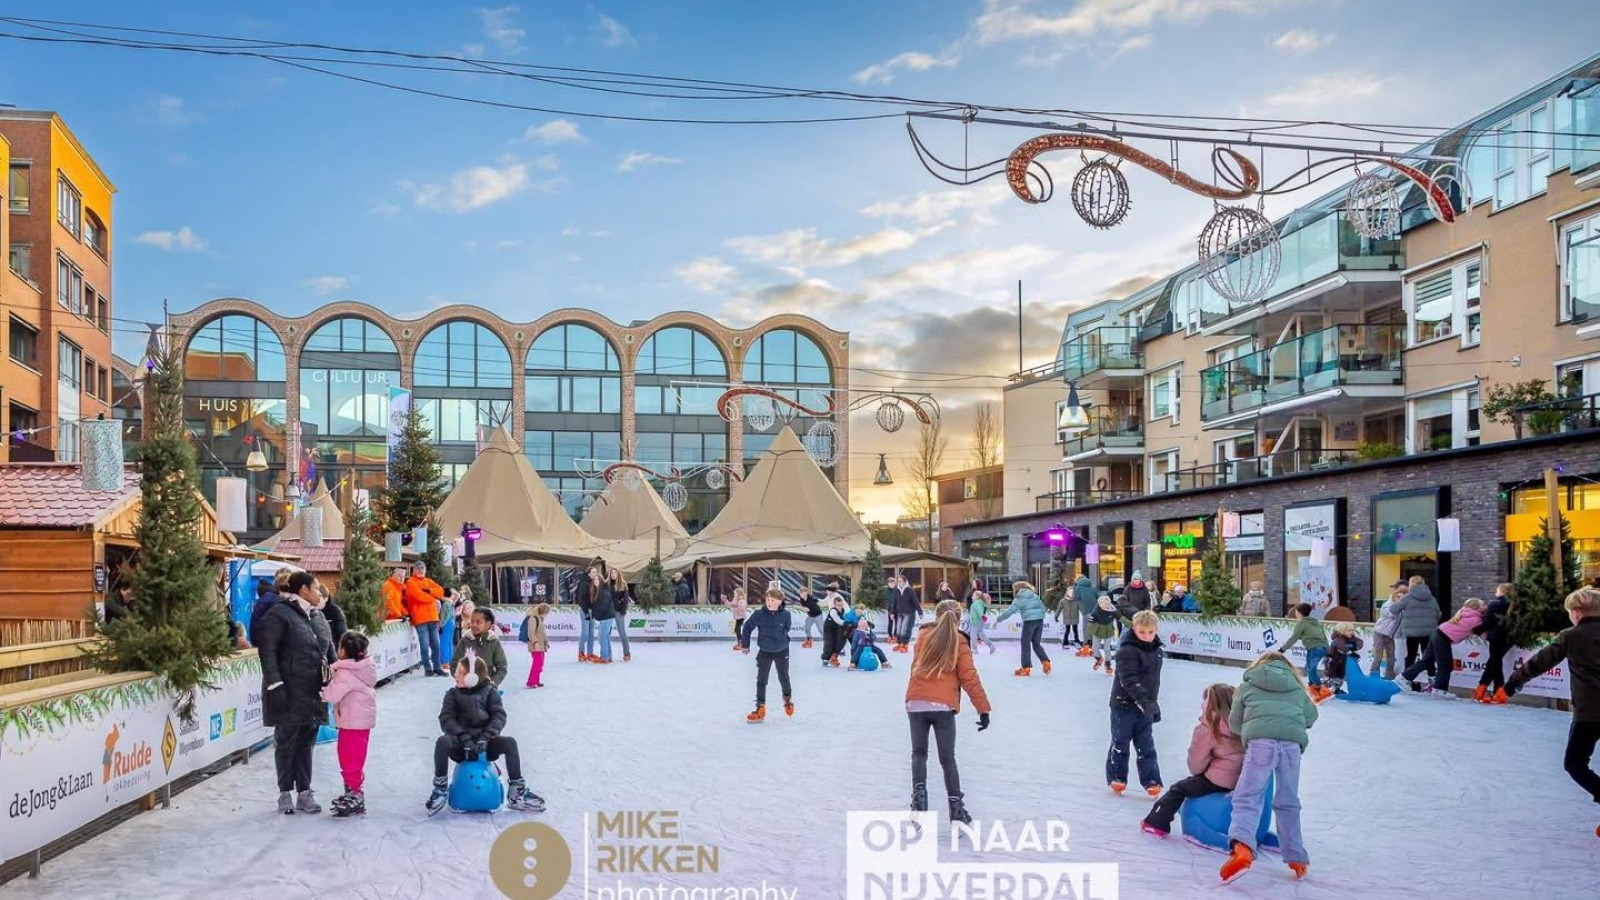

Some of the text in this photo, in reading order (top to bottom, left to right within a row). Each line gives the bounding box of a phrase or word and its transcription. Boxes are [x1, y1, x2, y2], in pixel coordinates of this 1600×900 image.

[312, 370, 387, 384] CULTUUR
[199, 399, 238, 413] HUIS
[114, 740, 152, 778] Rudde
